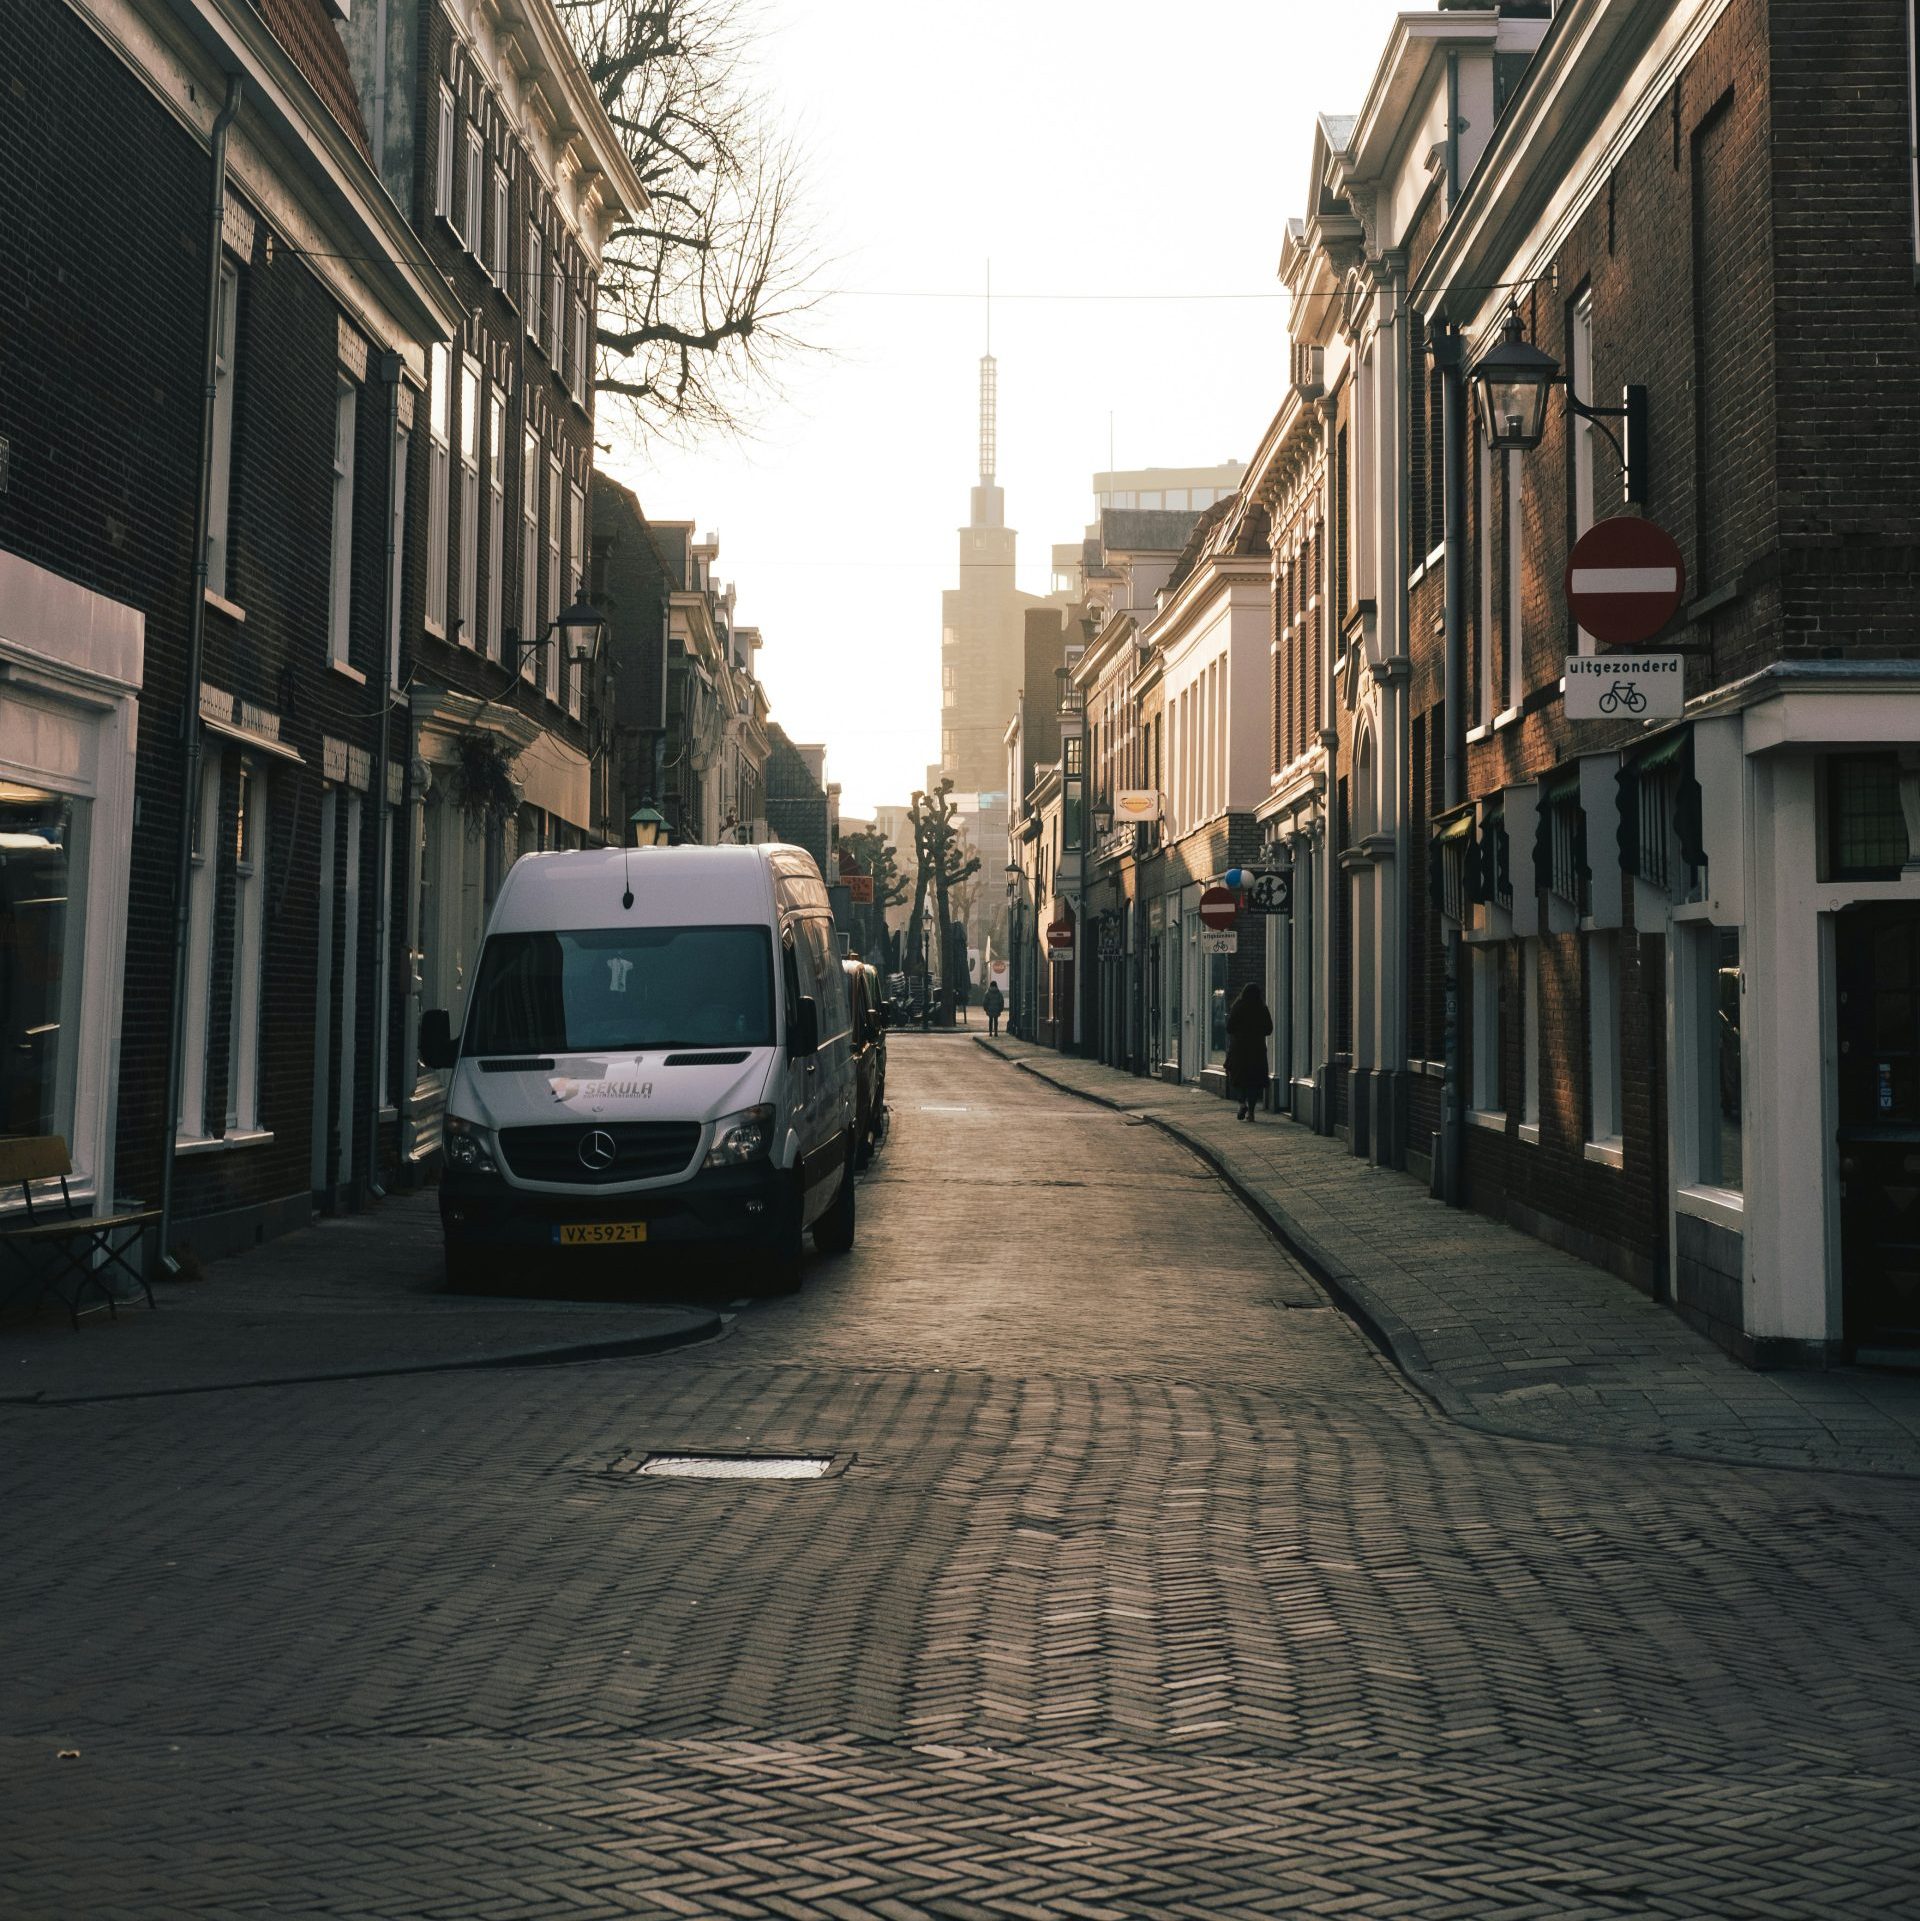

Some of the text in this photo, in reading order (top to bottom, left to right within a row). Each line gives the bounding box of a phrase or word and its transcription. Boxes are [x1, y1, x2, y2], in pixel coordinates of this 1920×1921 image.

[1570, 659, 1678, 677] uitgezonderd
[584, 1082, 654, 1096] SEKULA
[566, 1225, 641, 1241] VX-592-T
